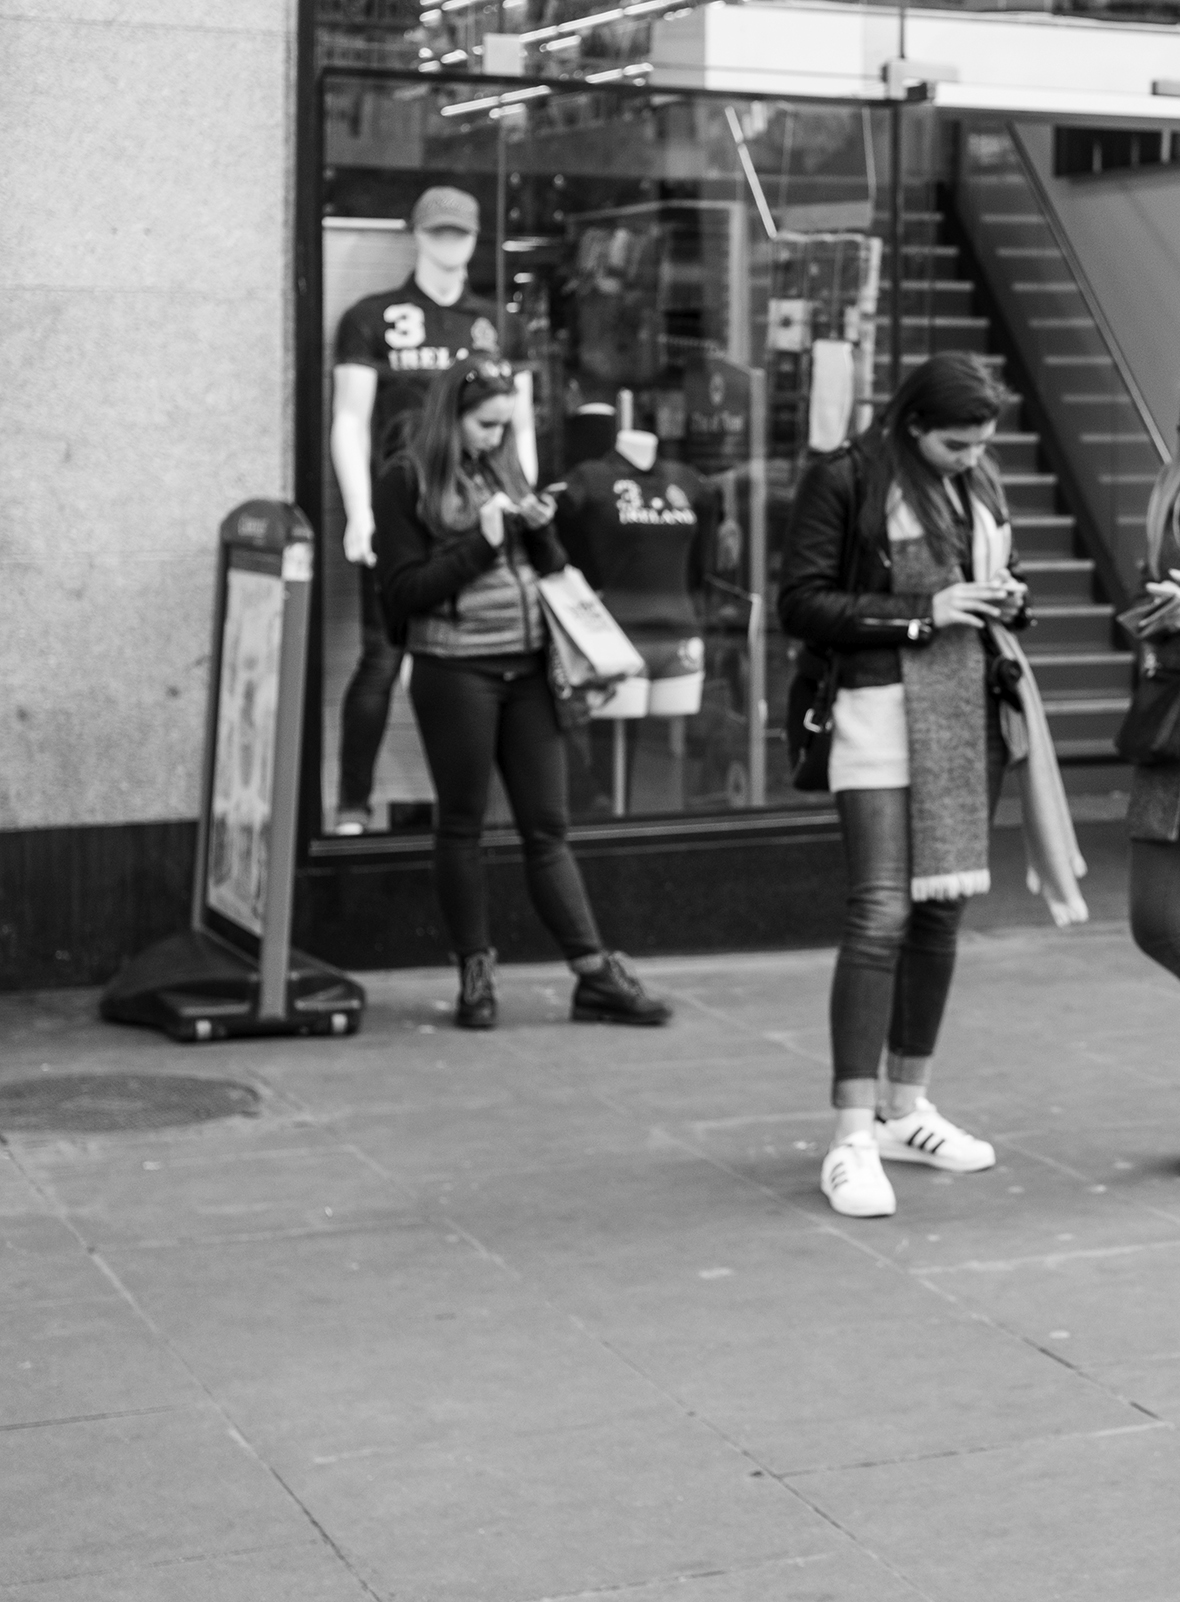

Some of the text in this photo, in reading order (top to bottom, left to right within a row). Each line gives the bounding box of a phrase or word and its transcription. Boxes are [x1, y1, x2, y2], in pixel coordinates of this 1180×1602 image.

[383, 303, 426, 349] 3
[388, 347, 456, 371] IREL
[613, 479, 644, 511] 3
[619, 507, 697, 525] IRELAND
